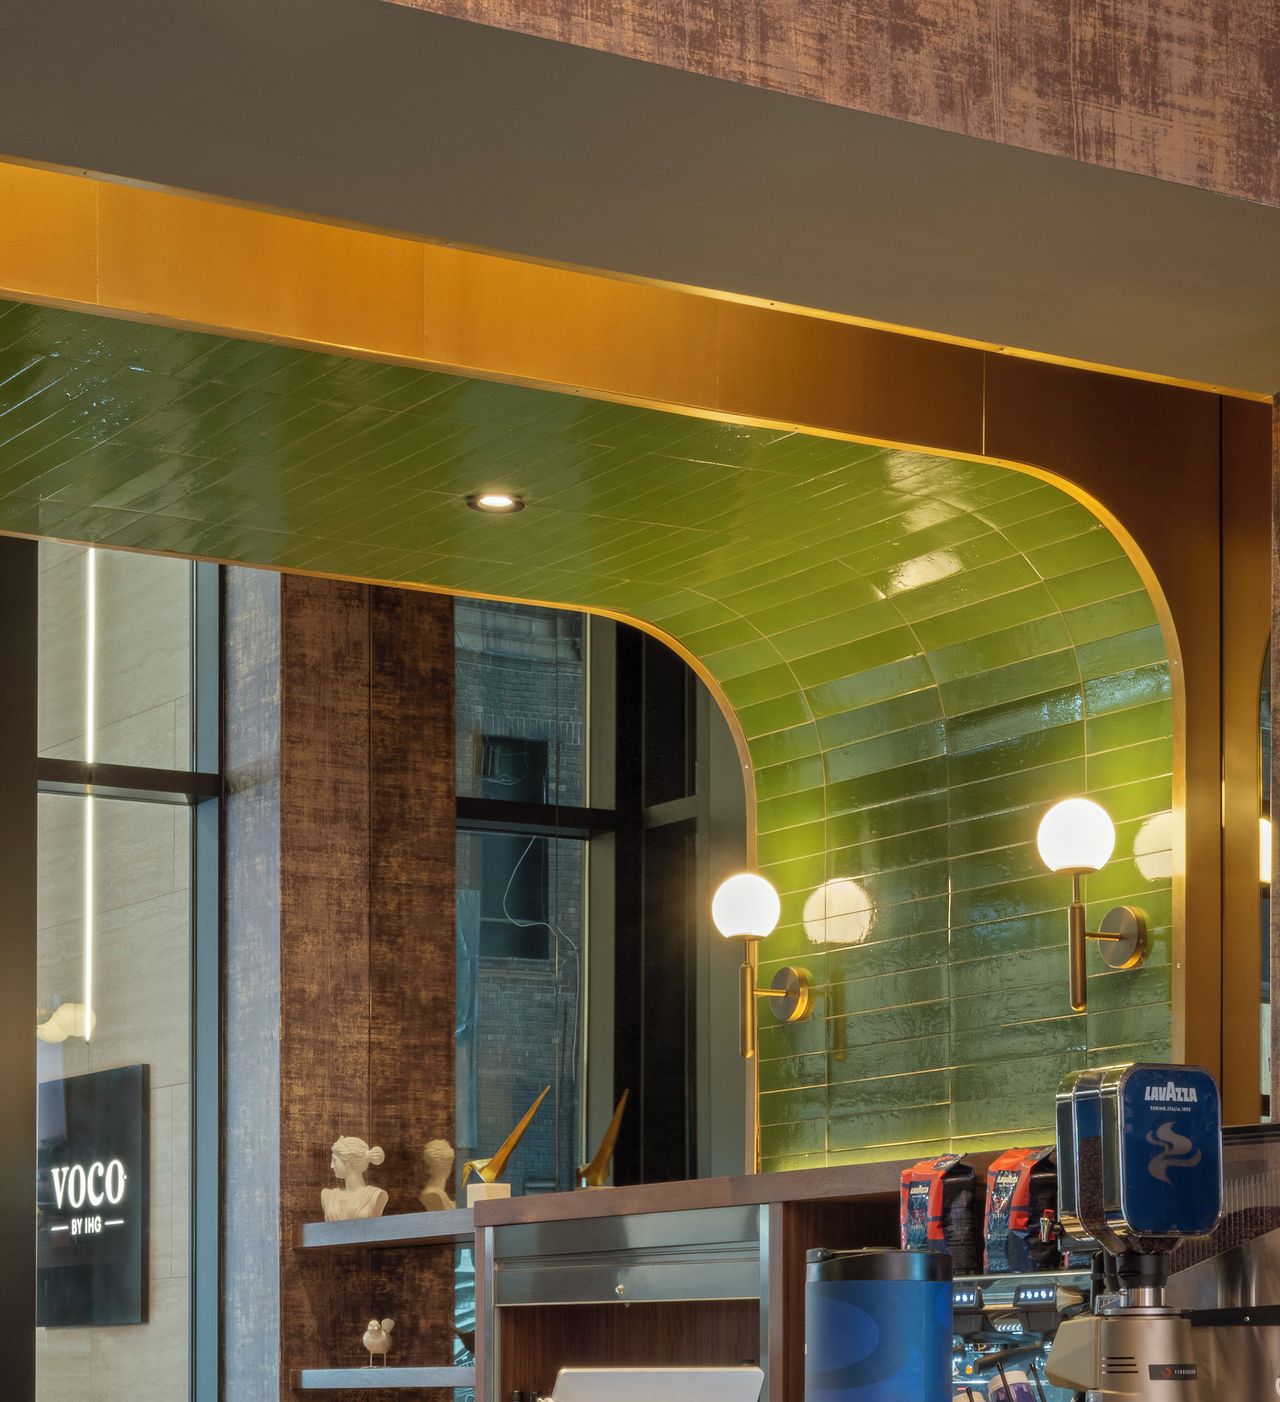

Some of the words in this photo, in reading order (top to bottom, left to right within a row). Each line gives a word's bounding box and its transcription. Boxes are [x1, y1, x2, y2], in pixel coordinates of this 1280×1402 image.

[1144, 1081, 1198, 1103] LAVAZZA
[50, 1159, 125, 1210] VOCO
[71, 1218, 83, 1235] BY
[84, 1216, 102, 1234] IHG
